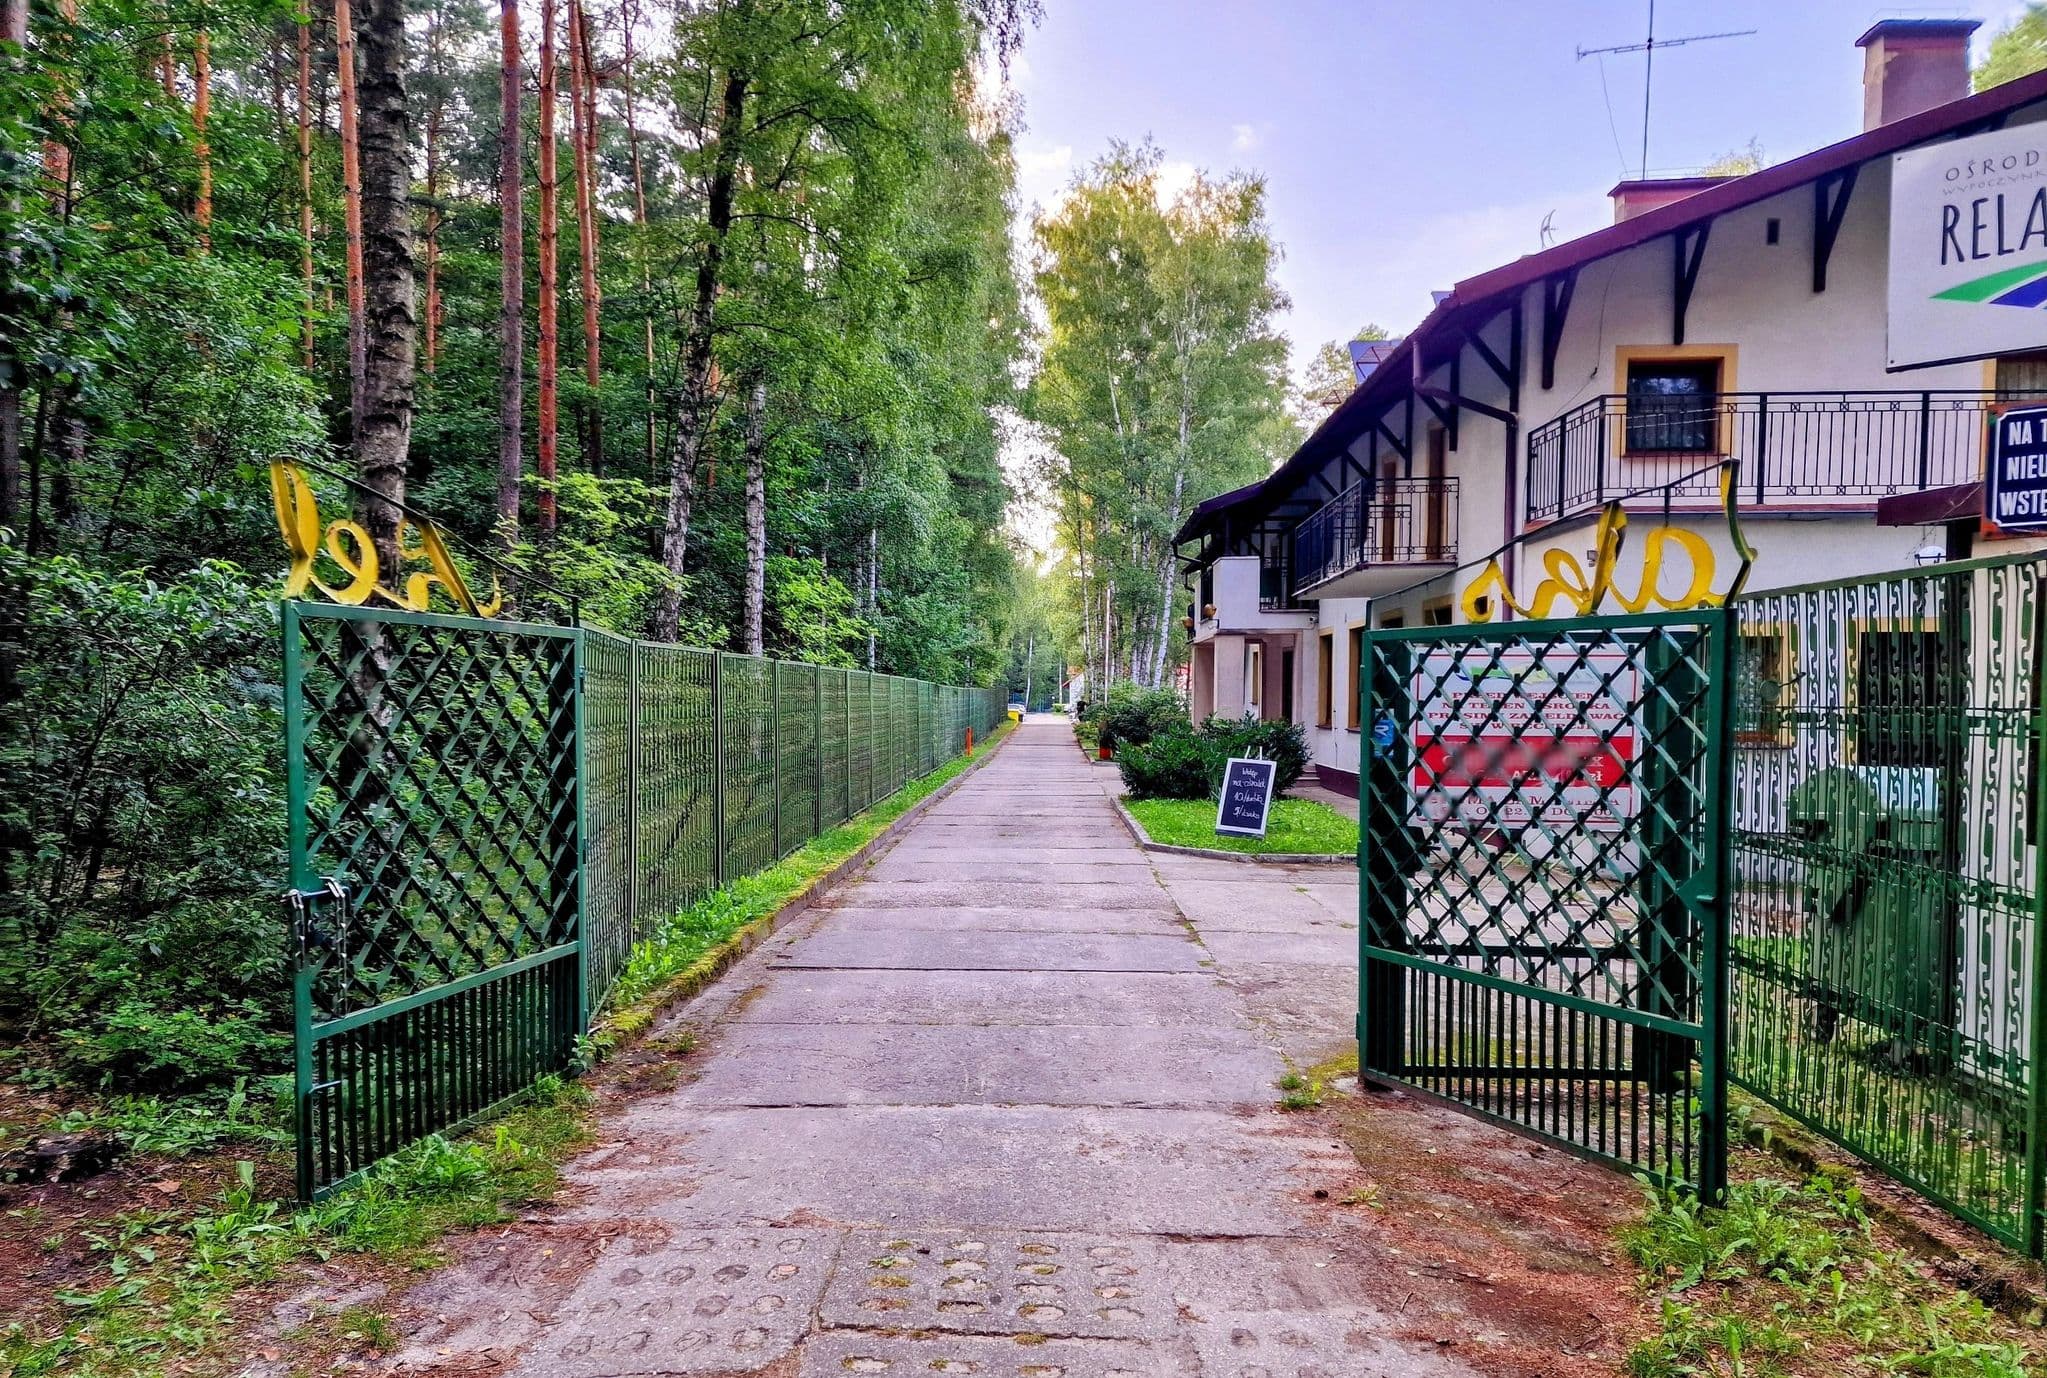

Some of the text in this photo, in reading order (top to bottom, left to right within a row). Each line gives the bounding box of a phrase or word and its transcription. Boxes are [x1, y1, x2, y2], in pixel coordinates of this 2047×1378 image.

[1941, 187, 2047, 265] RELA
[2008, 420, 2033, 446] NA
[2006, 453, 2047, 481] NIEU
[1469, 702, 1525, 710] TEEN
